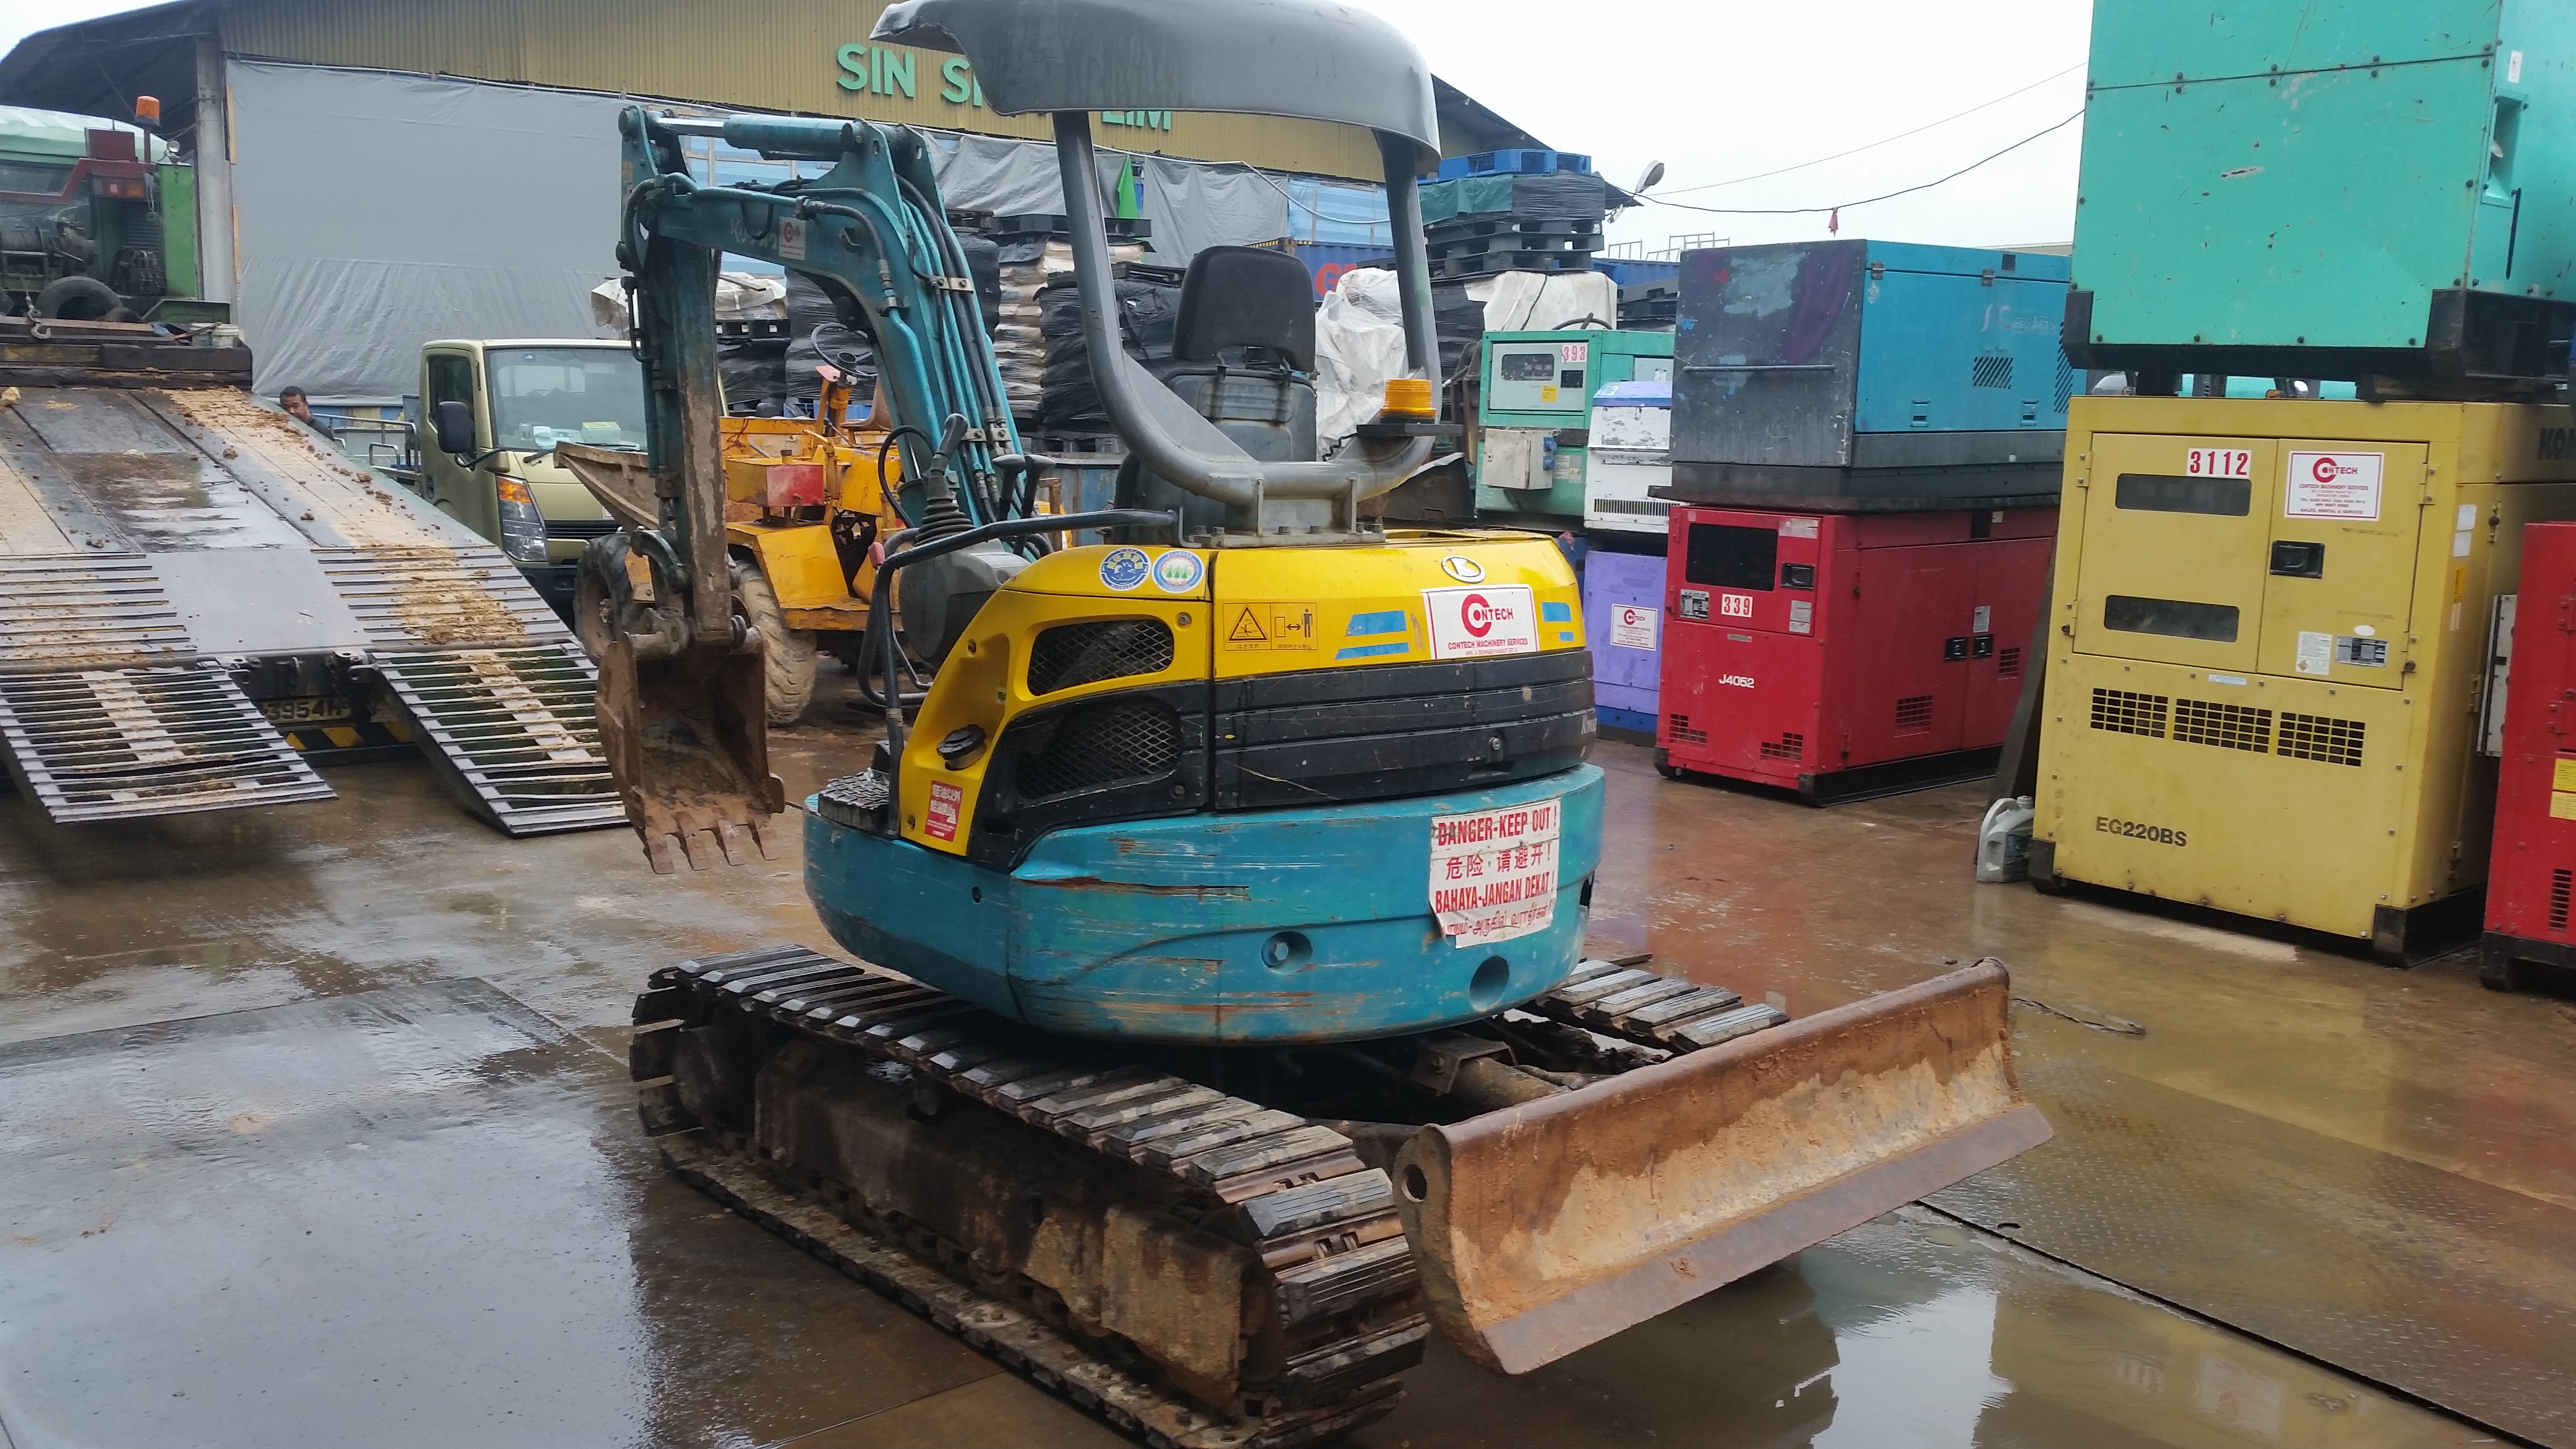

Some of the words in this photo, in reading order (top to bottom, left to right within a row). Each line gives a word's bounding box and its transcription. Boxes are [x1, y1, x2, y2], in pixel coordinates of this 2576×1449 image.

[837, 43, 915, 97] SIN
[1563, 345, 1585, 361] 393
[2190, 451, 2248, 475] 3112
[1724, 596, 1750, 615] 339
[1448, 641, 1475, 650] CONTECH
[1476, 639, 1506, 647] MACHINERY
[1718, 674, 1755, 688] J4052
[1438, 812, 1528, 846] DANGER-KEEP
[2096, 816, 2187, 847] EG220BS
[1436, 878, 1522, 914] BAHAYA-JANGAN
[1525, 871, 1550, 899] DEKAT
